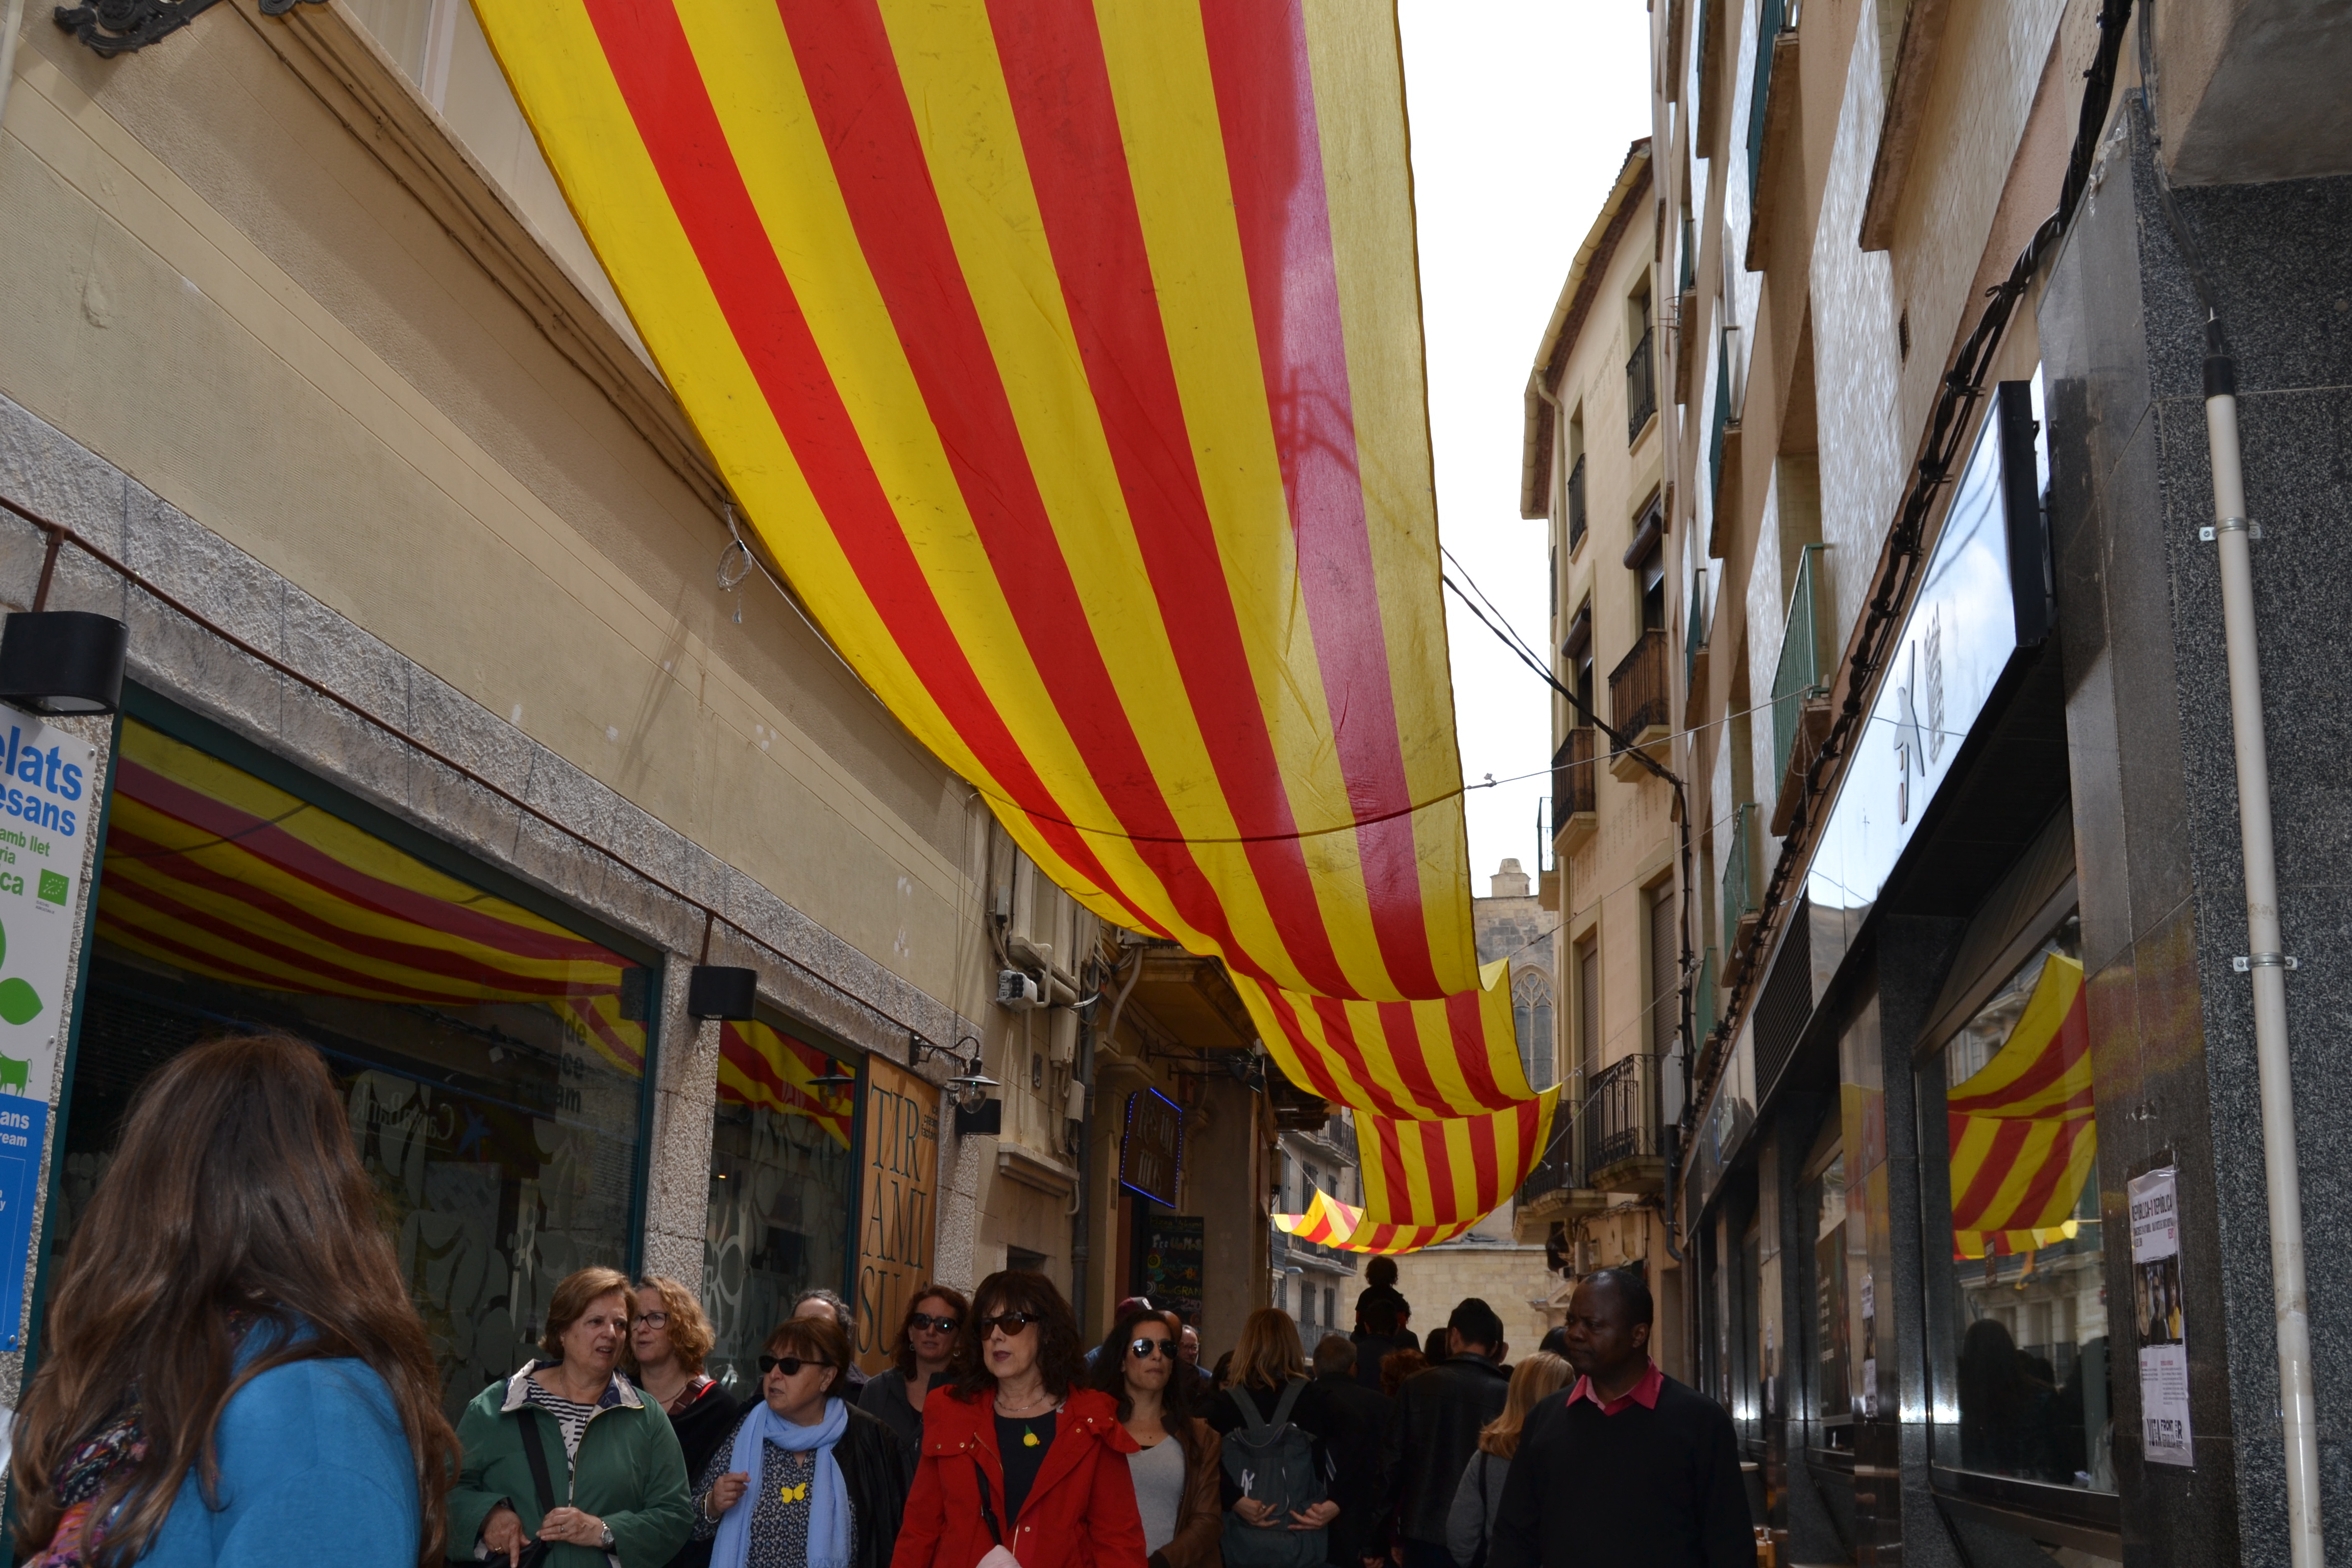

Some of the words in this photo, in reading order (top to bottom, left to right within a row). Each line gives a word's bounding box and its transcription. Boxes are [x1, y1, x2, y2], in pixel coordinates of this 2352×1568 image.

[30, 835, 50, 857] llet
[870, 1079, 920, 1182] TIR
[862, 1172, 927, 1269] AMI
